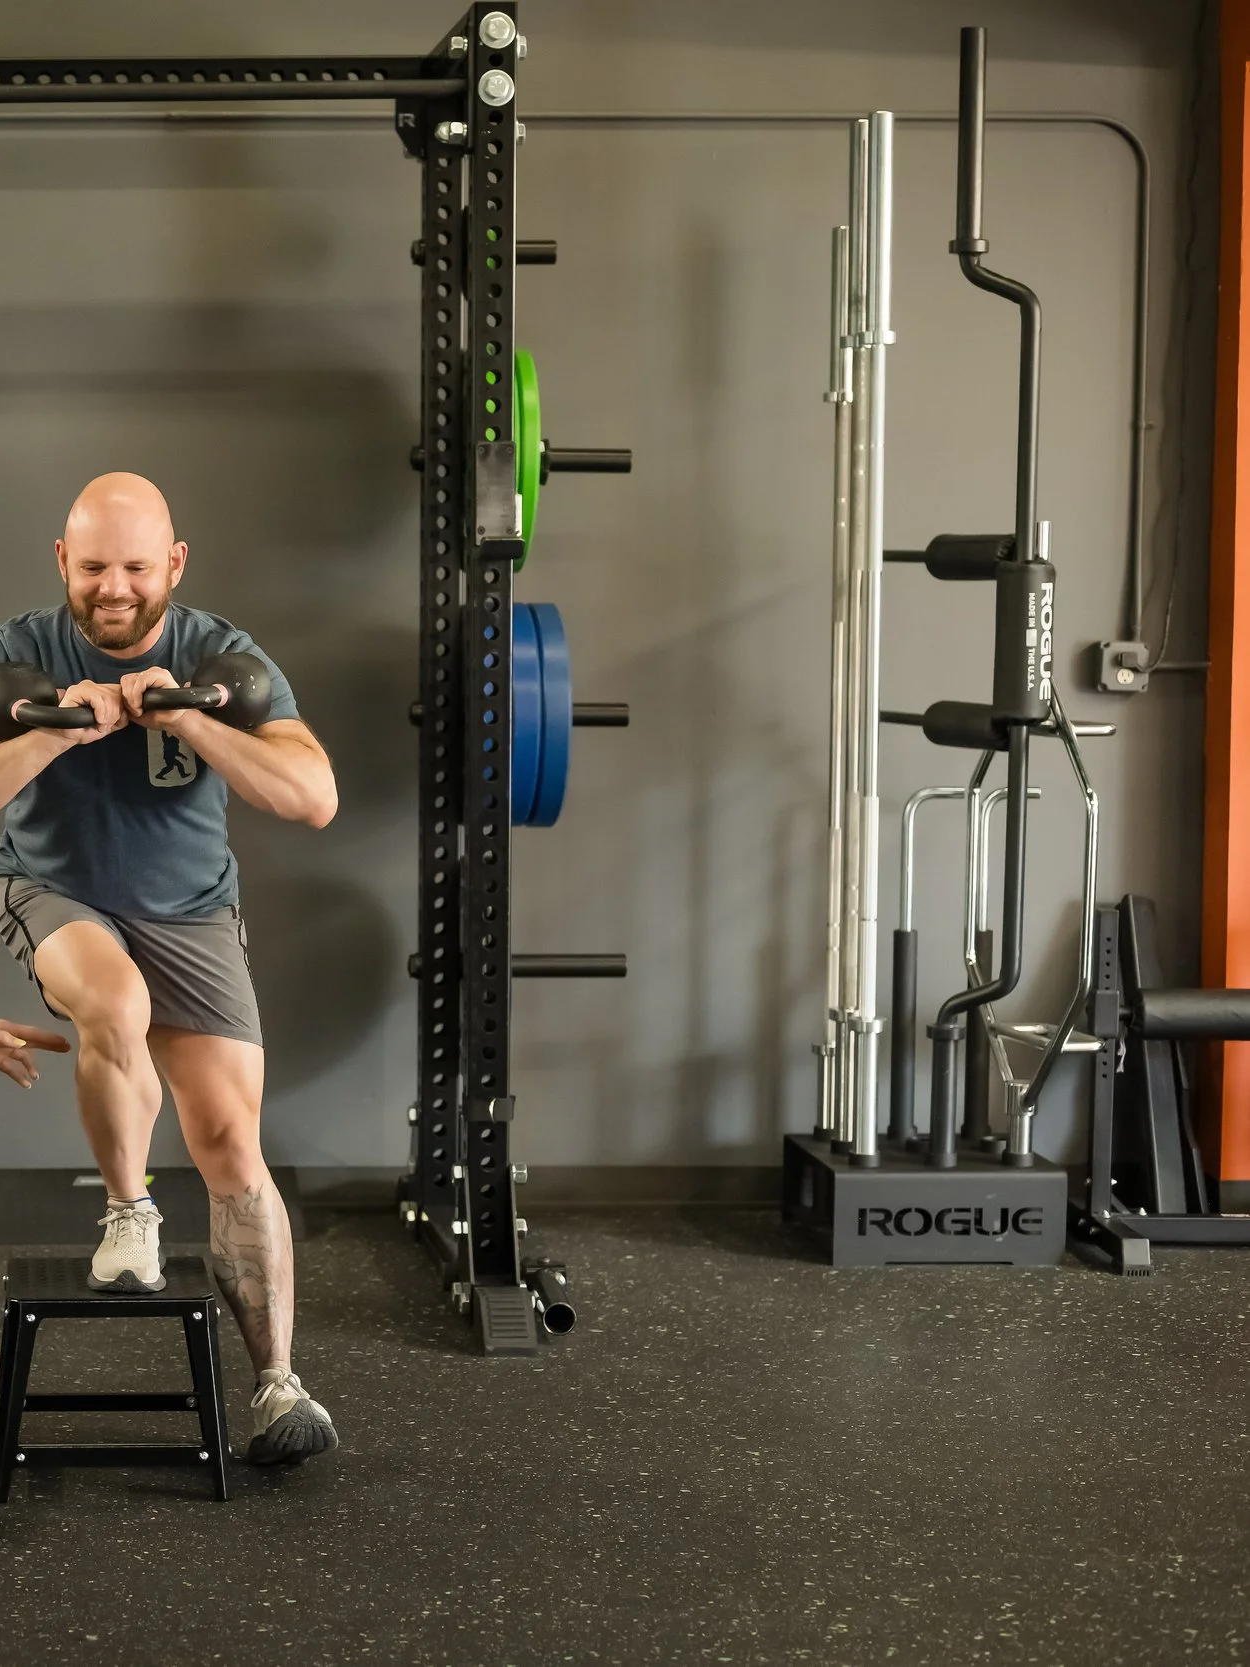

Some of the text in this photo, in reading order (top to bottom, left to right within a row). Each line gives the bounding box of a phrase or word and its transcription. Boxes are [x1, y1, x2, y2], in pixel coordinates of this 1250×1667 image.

[1028, 592, 1036, 617] MADE
[1028, 617, 1036, 628] IN
[1039, 582, 1053, 700] ROGUE
[1027, 648, 1036, 666] THE
[858, 1206, 1044, 1237] ROGUE
